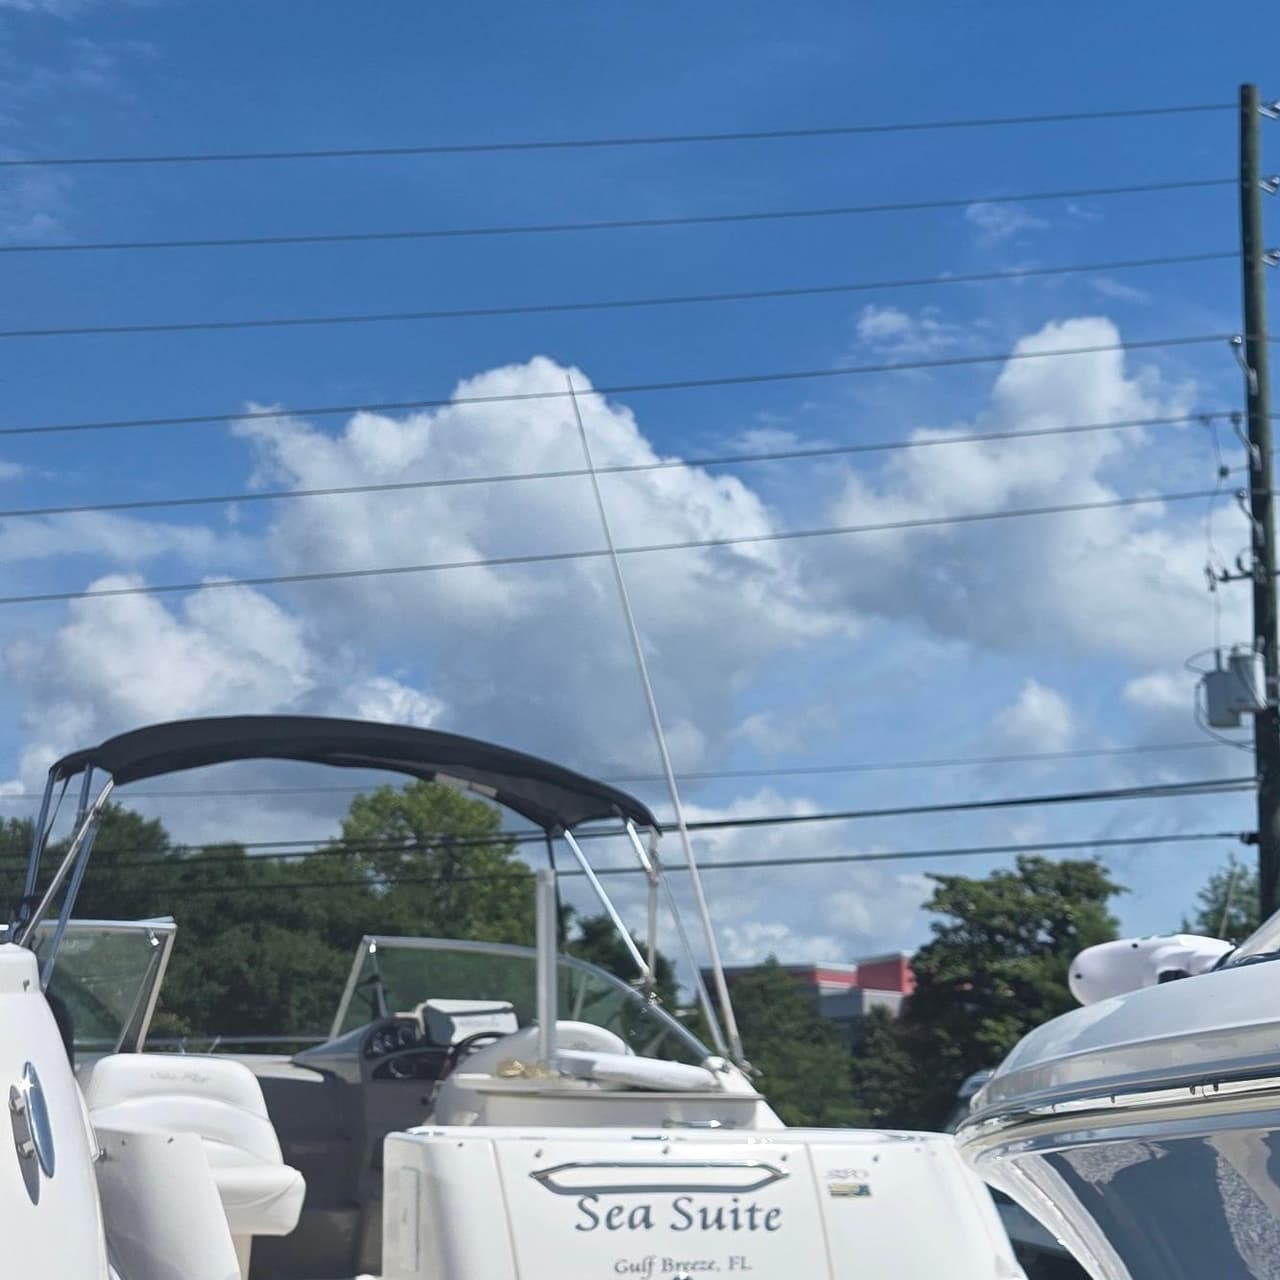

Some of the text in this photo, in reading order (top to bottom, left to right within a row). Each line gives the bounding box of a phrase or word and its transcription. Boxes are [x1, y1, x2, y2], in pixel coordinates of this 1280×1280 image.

[575, 1194, 783, 1231] Sea Suite
[614, 1255, 657, 1280] Gulf
[728, 1255, 752, 1270] FL
